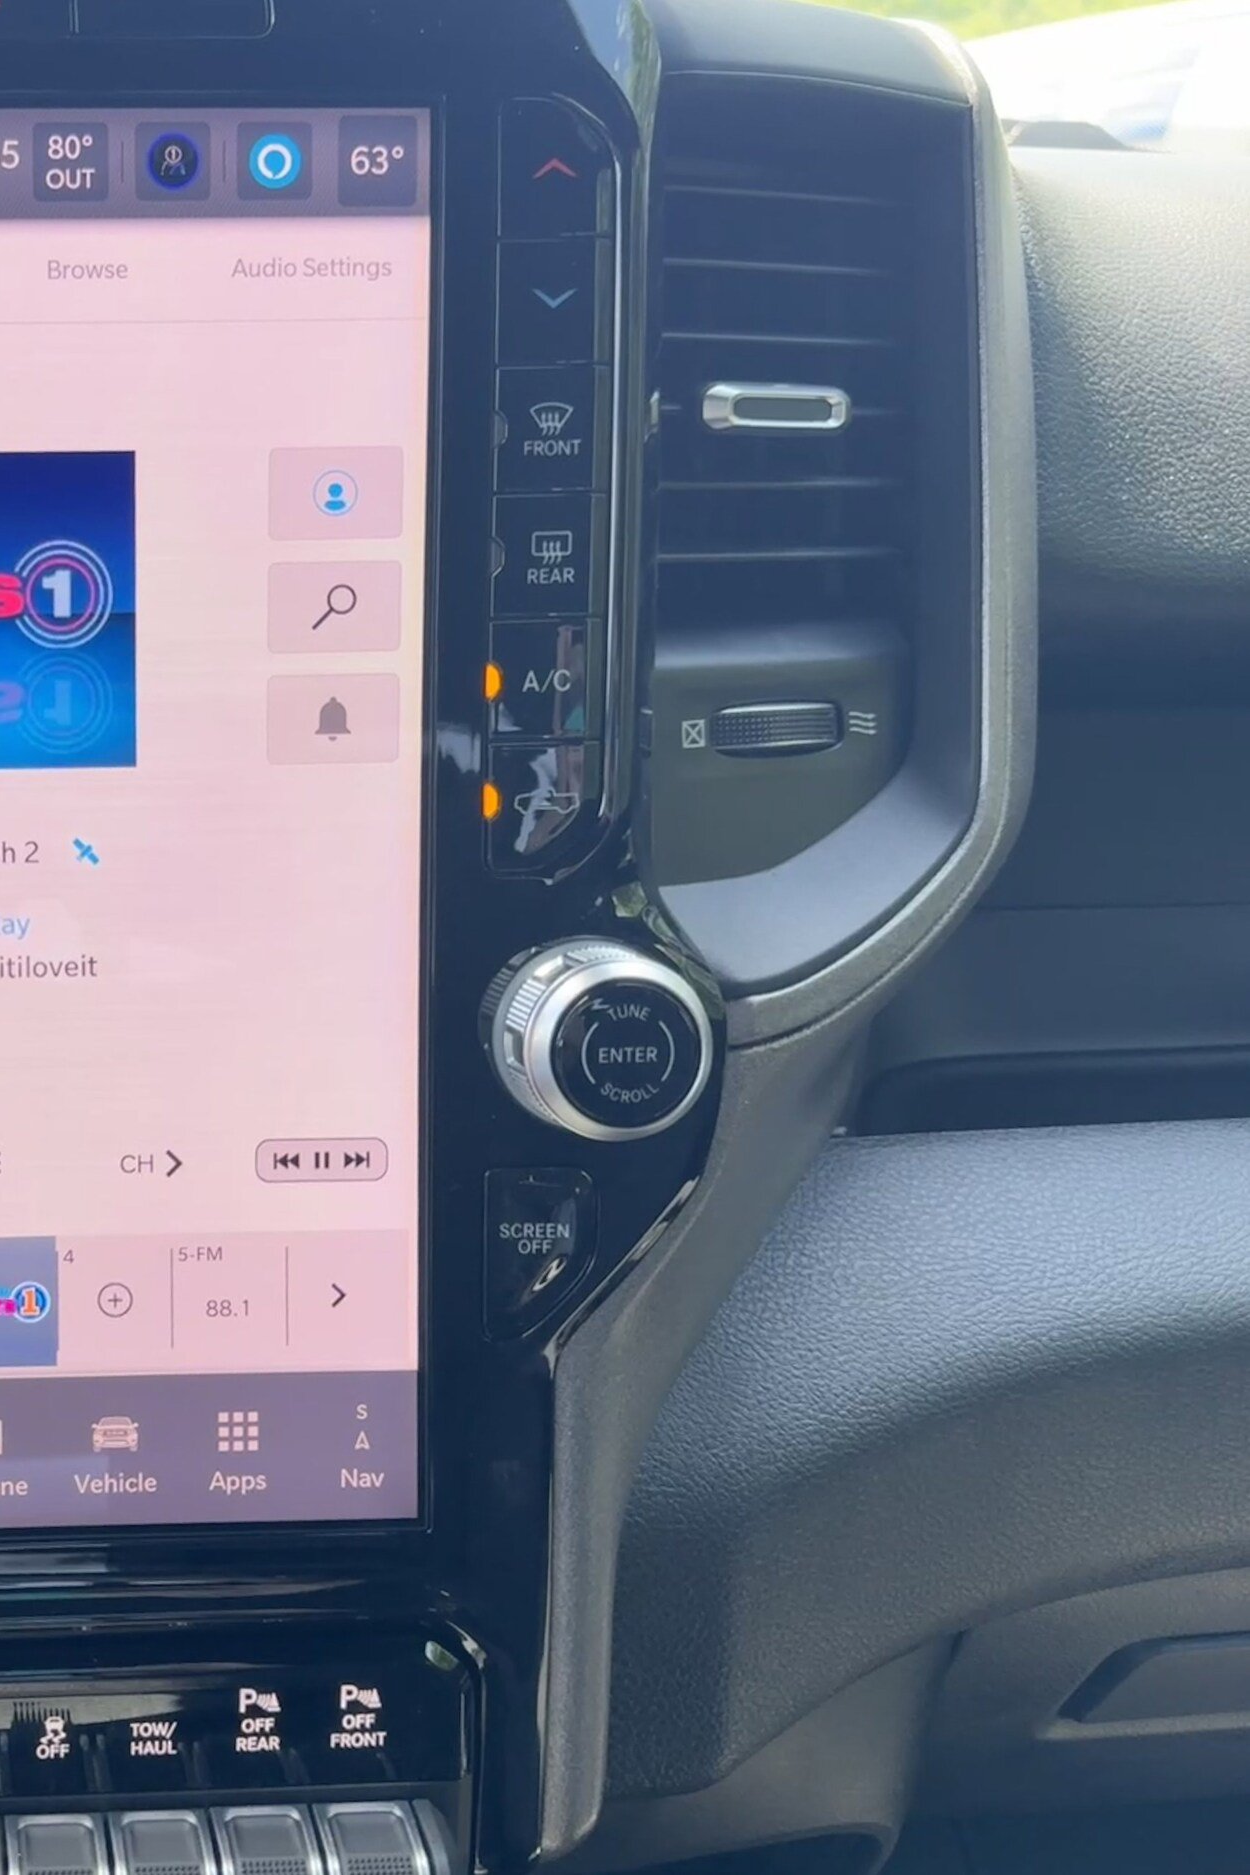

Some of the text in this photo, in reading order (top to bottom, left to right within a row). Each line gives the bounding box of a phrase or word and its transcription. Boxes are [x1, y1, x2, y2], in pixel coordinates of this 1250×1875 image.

[47, 135, 93, 160] 80°
[350, 145, 405, 176] 63°
[45, 168, 95, 190] OUT
[46, 259, 129, 281] Browse
[231, 256, 392, 282] Audio Settings
[523, 439, 582, 456] FRONT
[526, 567, 575, 584] REAR
[42, 569, 72, 618] 1
[522, 669, 572, 694] A/C
[24, 840, 40, 863] 2
[605, 1002, 651, 1023] TUNE
[598, 1046, 658, 1065] ENTER
[600, 1082, 659, 1104] SCROLL
[119, 1154, 154, 1174] CH
[499, 1223, 571, 1240] SCREEN
[178, 1246, 223, 1262] 5-FM
[517, 1238, 553, 1255] OFF
[62, 1249, 75, 1265] 4
[205, 1299, 250, 1318] 88.1
[356, 1403, 368, 1421] S
[74, 1472, 158, 1495] Vehicle
[209, 1470, 267, 1496] Apps
[340, 1468, 385, 1489] Nav
[130, 1720, 178, 1740] TOW/
[241, 1718, 276, 1735] OFF
[342, 1714, 376, 1731] OFF
[130, 1739, 178, 1756] HAUL
[235, 1734, 280, 1752] REAR
[330, 1731, 387, 1749] FRONT
[36, 1743, 70, 1760] OFF
